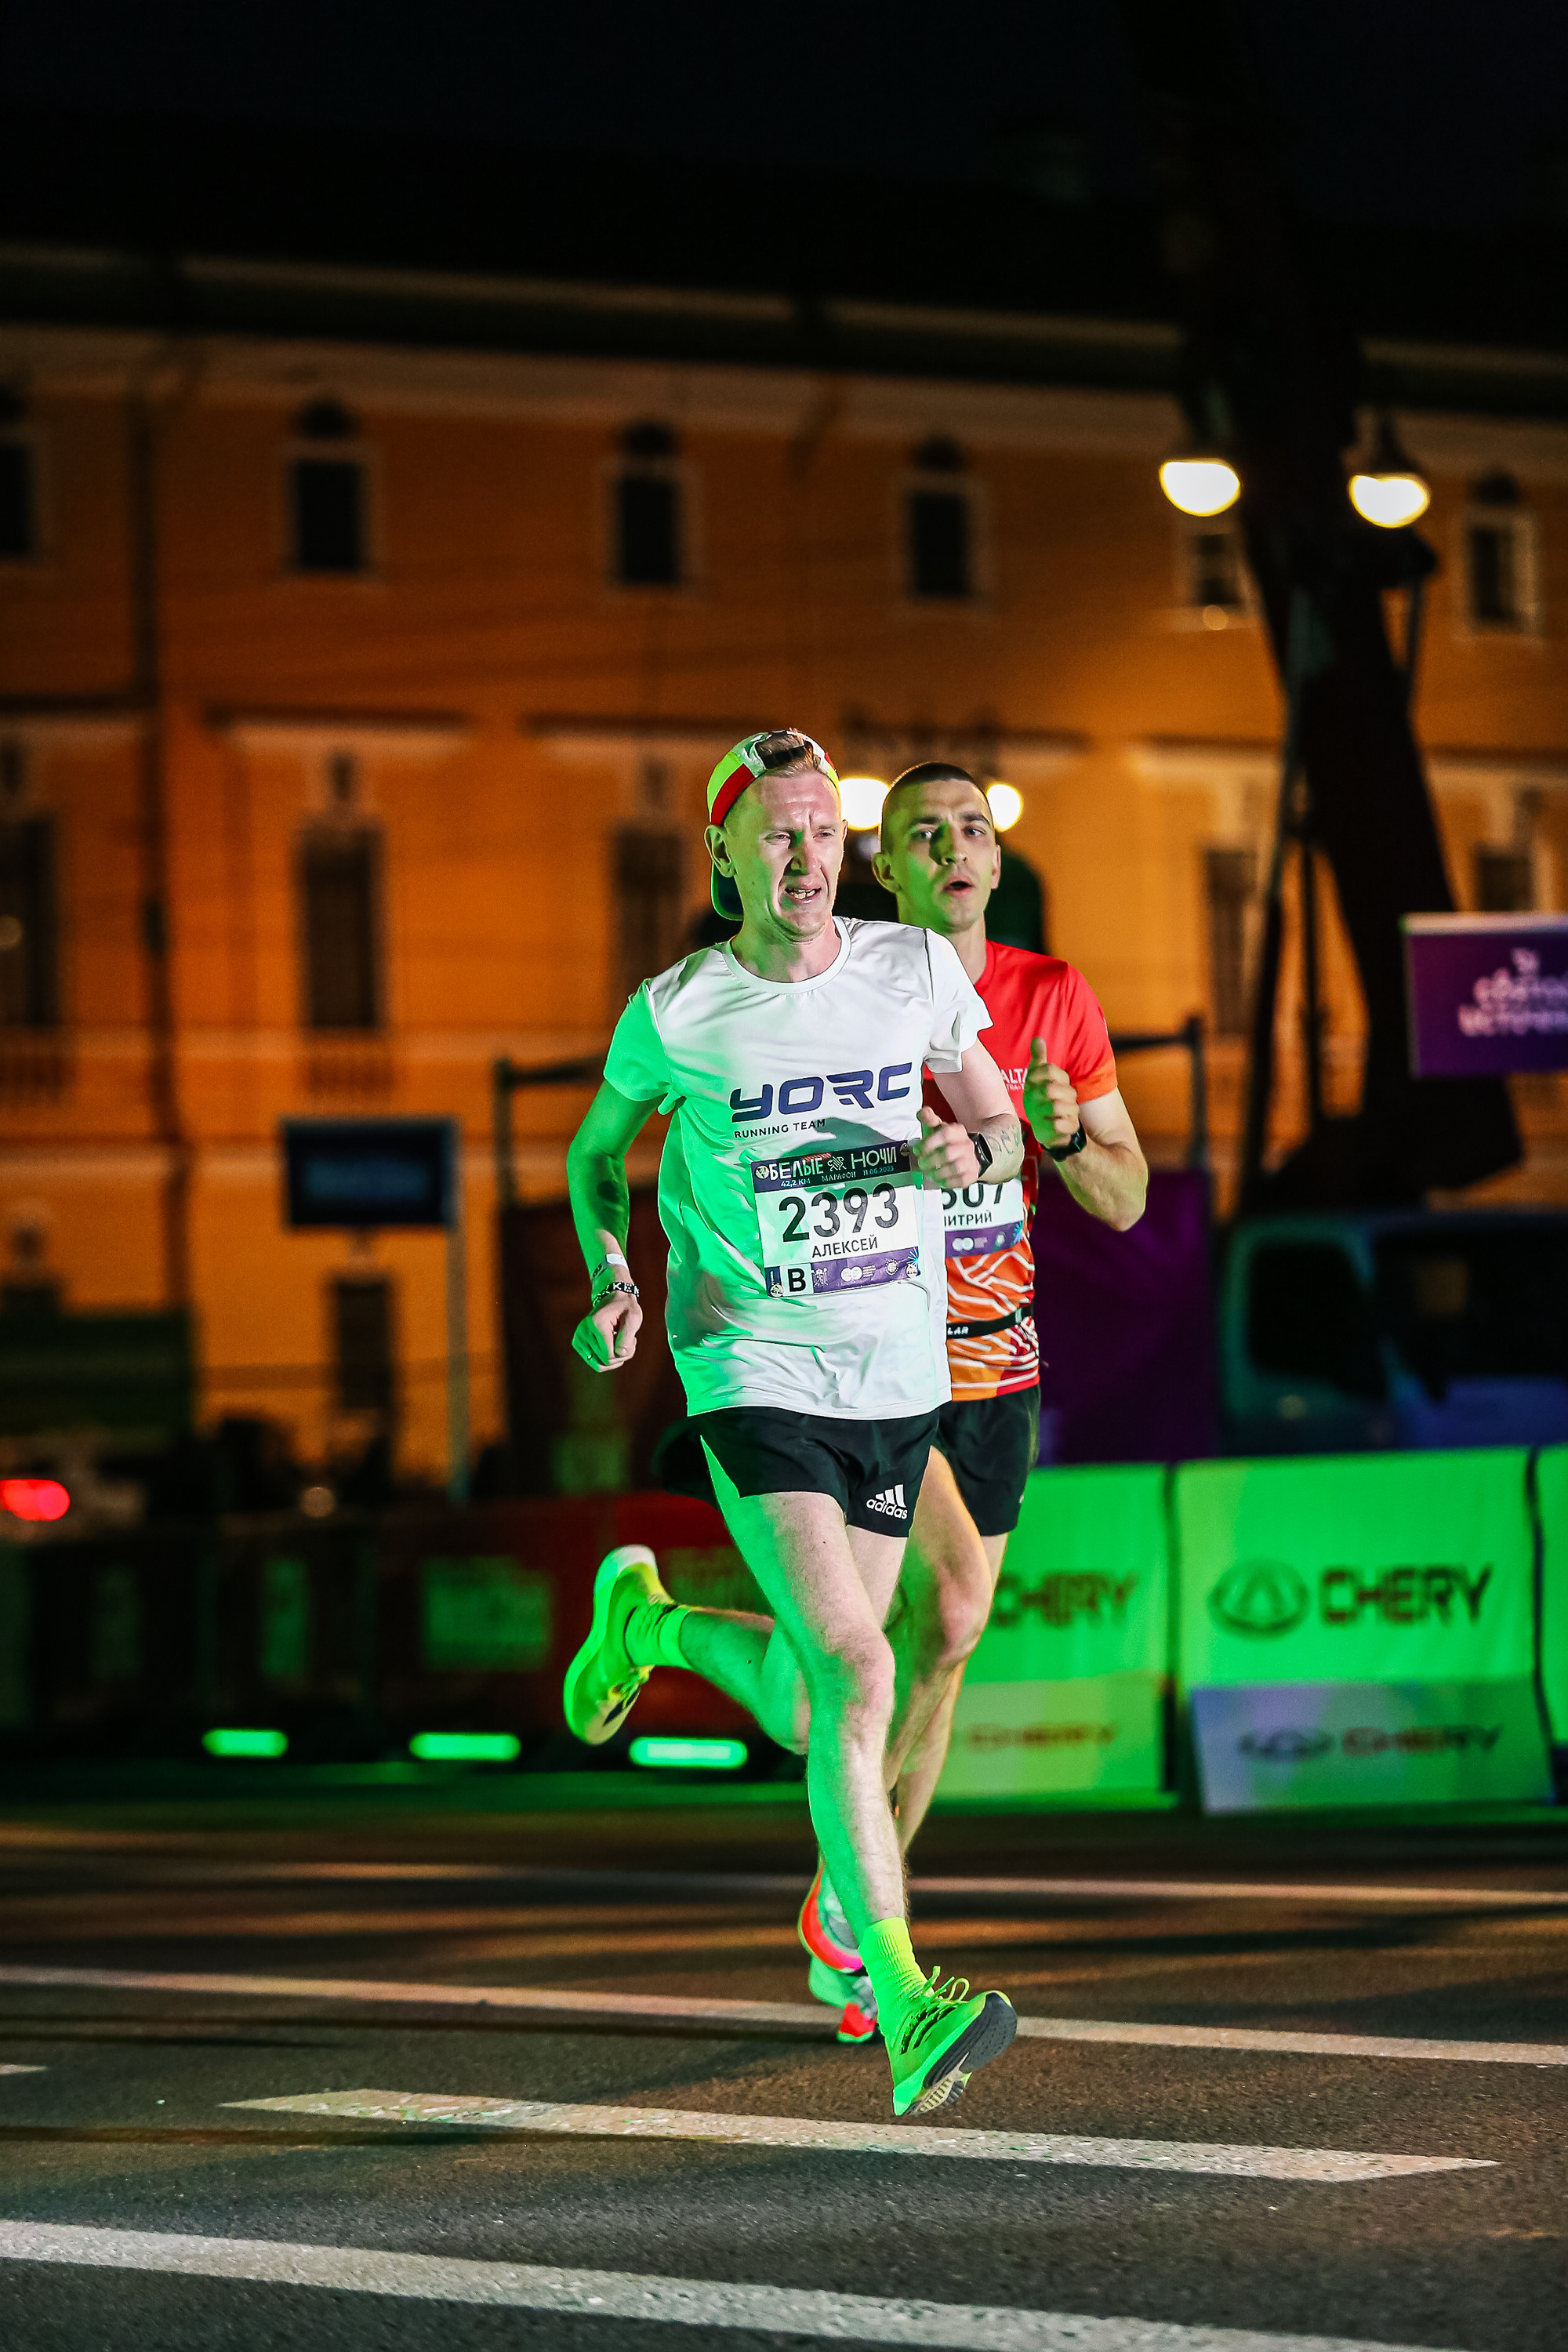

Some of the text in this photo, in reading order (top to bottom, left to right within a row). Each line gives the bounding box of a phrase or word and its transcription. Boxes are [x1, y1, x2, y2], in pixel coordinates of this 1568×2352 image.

[730, 1062, 912, 1123] YORC
[735, 1119, 826, 1138] RUNNING TEAM
[769, 1146, 897, 1181] БЕЛЫЕ НОЧИ
[822, 1171, 856, 1182] МАРАФОН
[779, 1182, 898, 1243] 2393
[943, 1210, 992, 1227] ИТРИЙ
[812, 1234, 878, 1258] АЛЕКСЕЙ
[866, 1498, 908, 1519] adidas
[1319, 1563, 1494, 1626] CHERY
